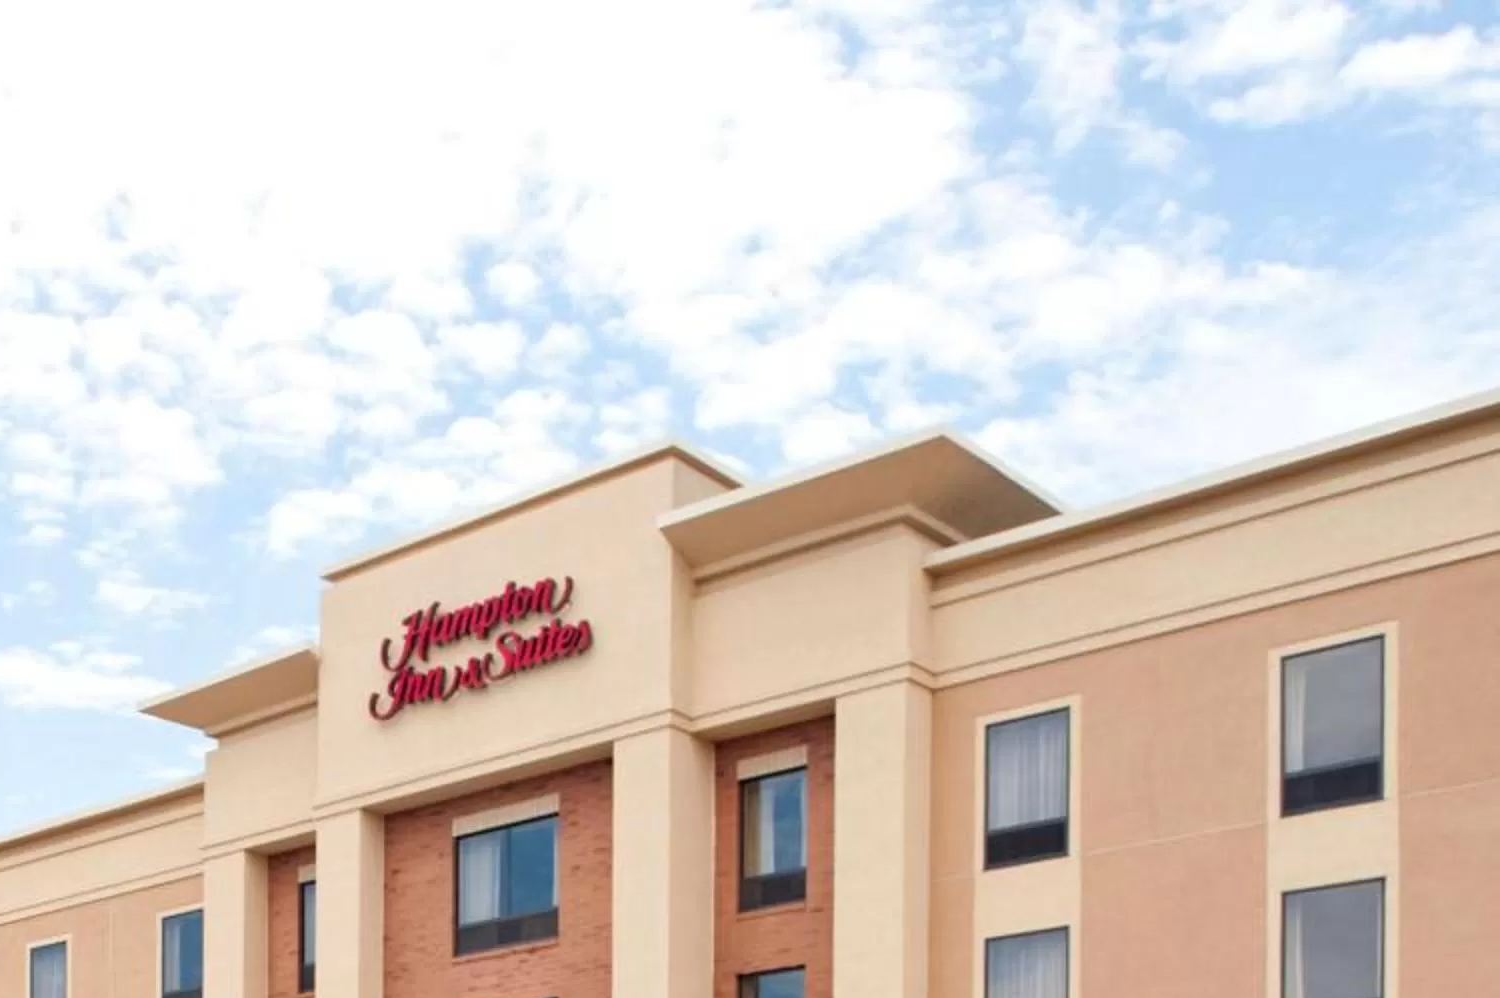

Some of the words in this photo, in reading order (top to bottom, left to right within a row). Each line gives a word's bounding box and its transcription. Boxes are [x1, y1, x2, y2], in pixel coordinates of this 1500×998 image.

[369, 665, 460, 720] Inn
[484, 617, 594, 681] Suites
[381, 576, 573, 671] Hampton
